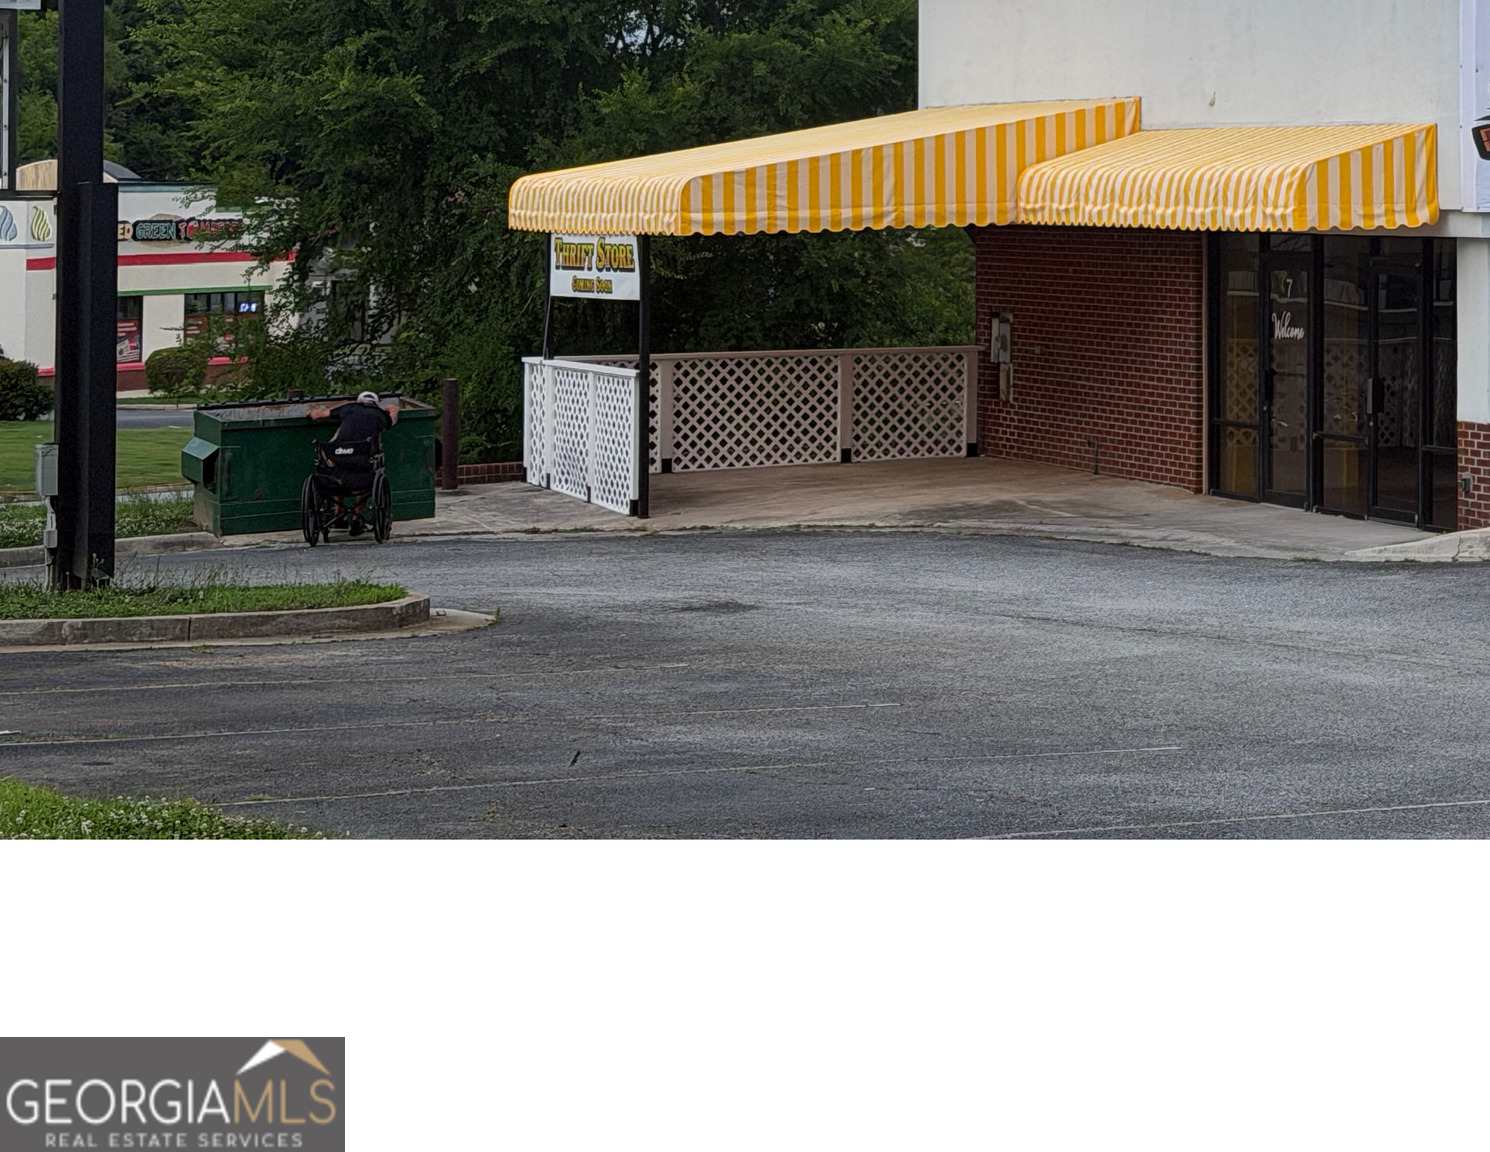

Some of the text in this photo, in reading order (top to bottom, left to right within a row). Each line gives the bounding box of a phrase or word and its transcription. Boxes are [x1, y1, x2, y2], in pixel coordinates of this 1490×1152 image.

[118, 222, 134, 240] ED
[135, 222, 177, 240] GREEN
[554, 236, 636, 272] THRIFT STORE
[1286, 279, 1293, 298] 7
[1272, 311, 1304, 339] Welcome
